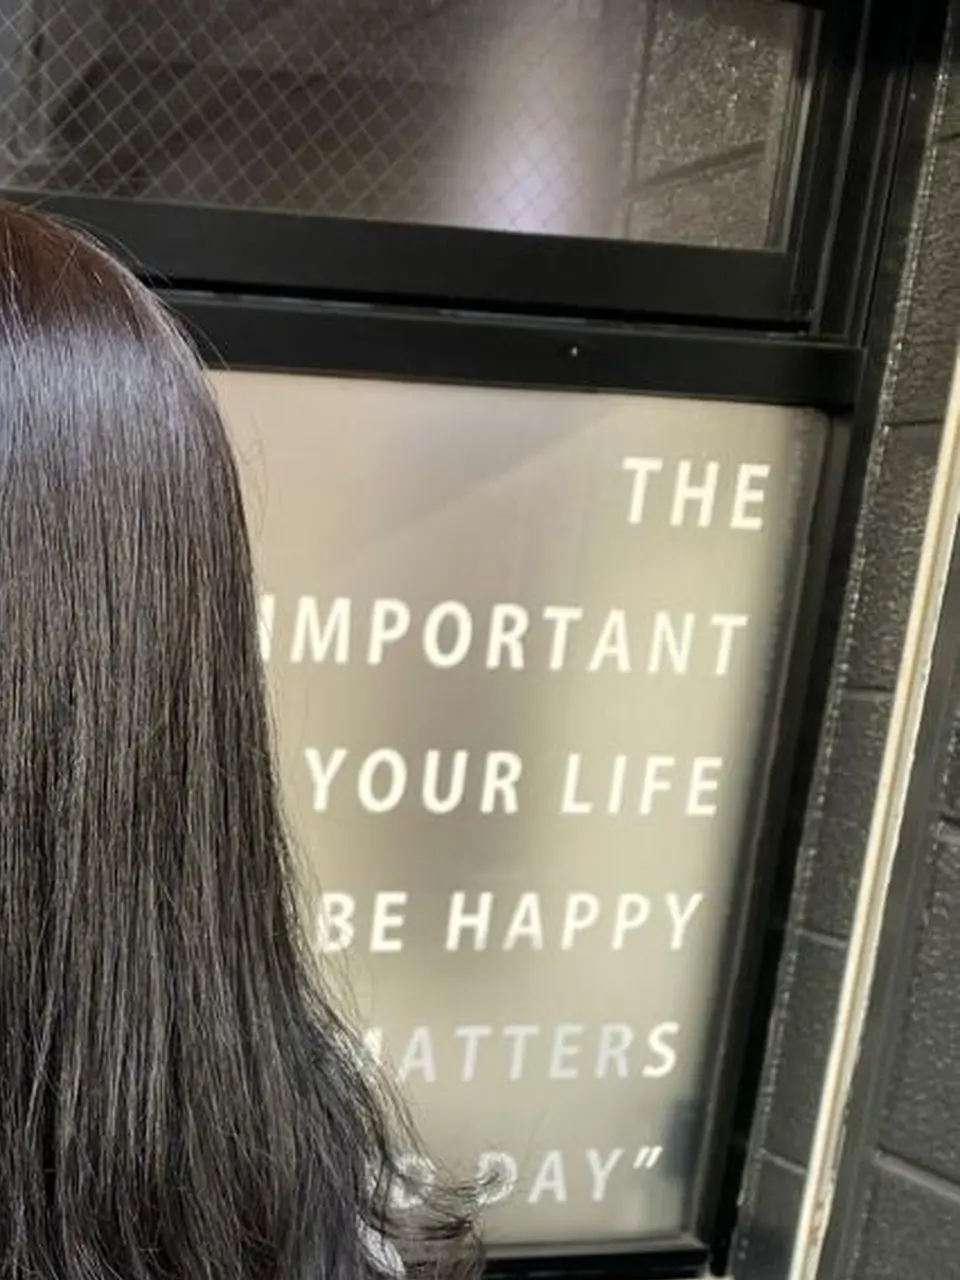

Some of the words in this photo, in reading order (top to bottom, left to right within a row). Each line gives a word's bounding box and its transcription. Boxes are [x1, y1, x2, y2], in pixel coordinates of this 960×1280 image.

[622, 457, 770, 531] THE
[259, 593, 748, 677] IMPORTANT
[304, 748, 522, 814] YOUR
[560, 752, 723, 817] LIFE
[317, 891, 408, 952] BE
[445, 891, 703, 953] HAPPY
